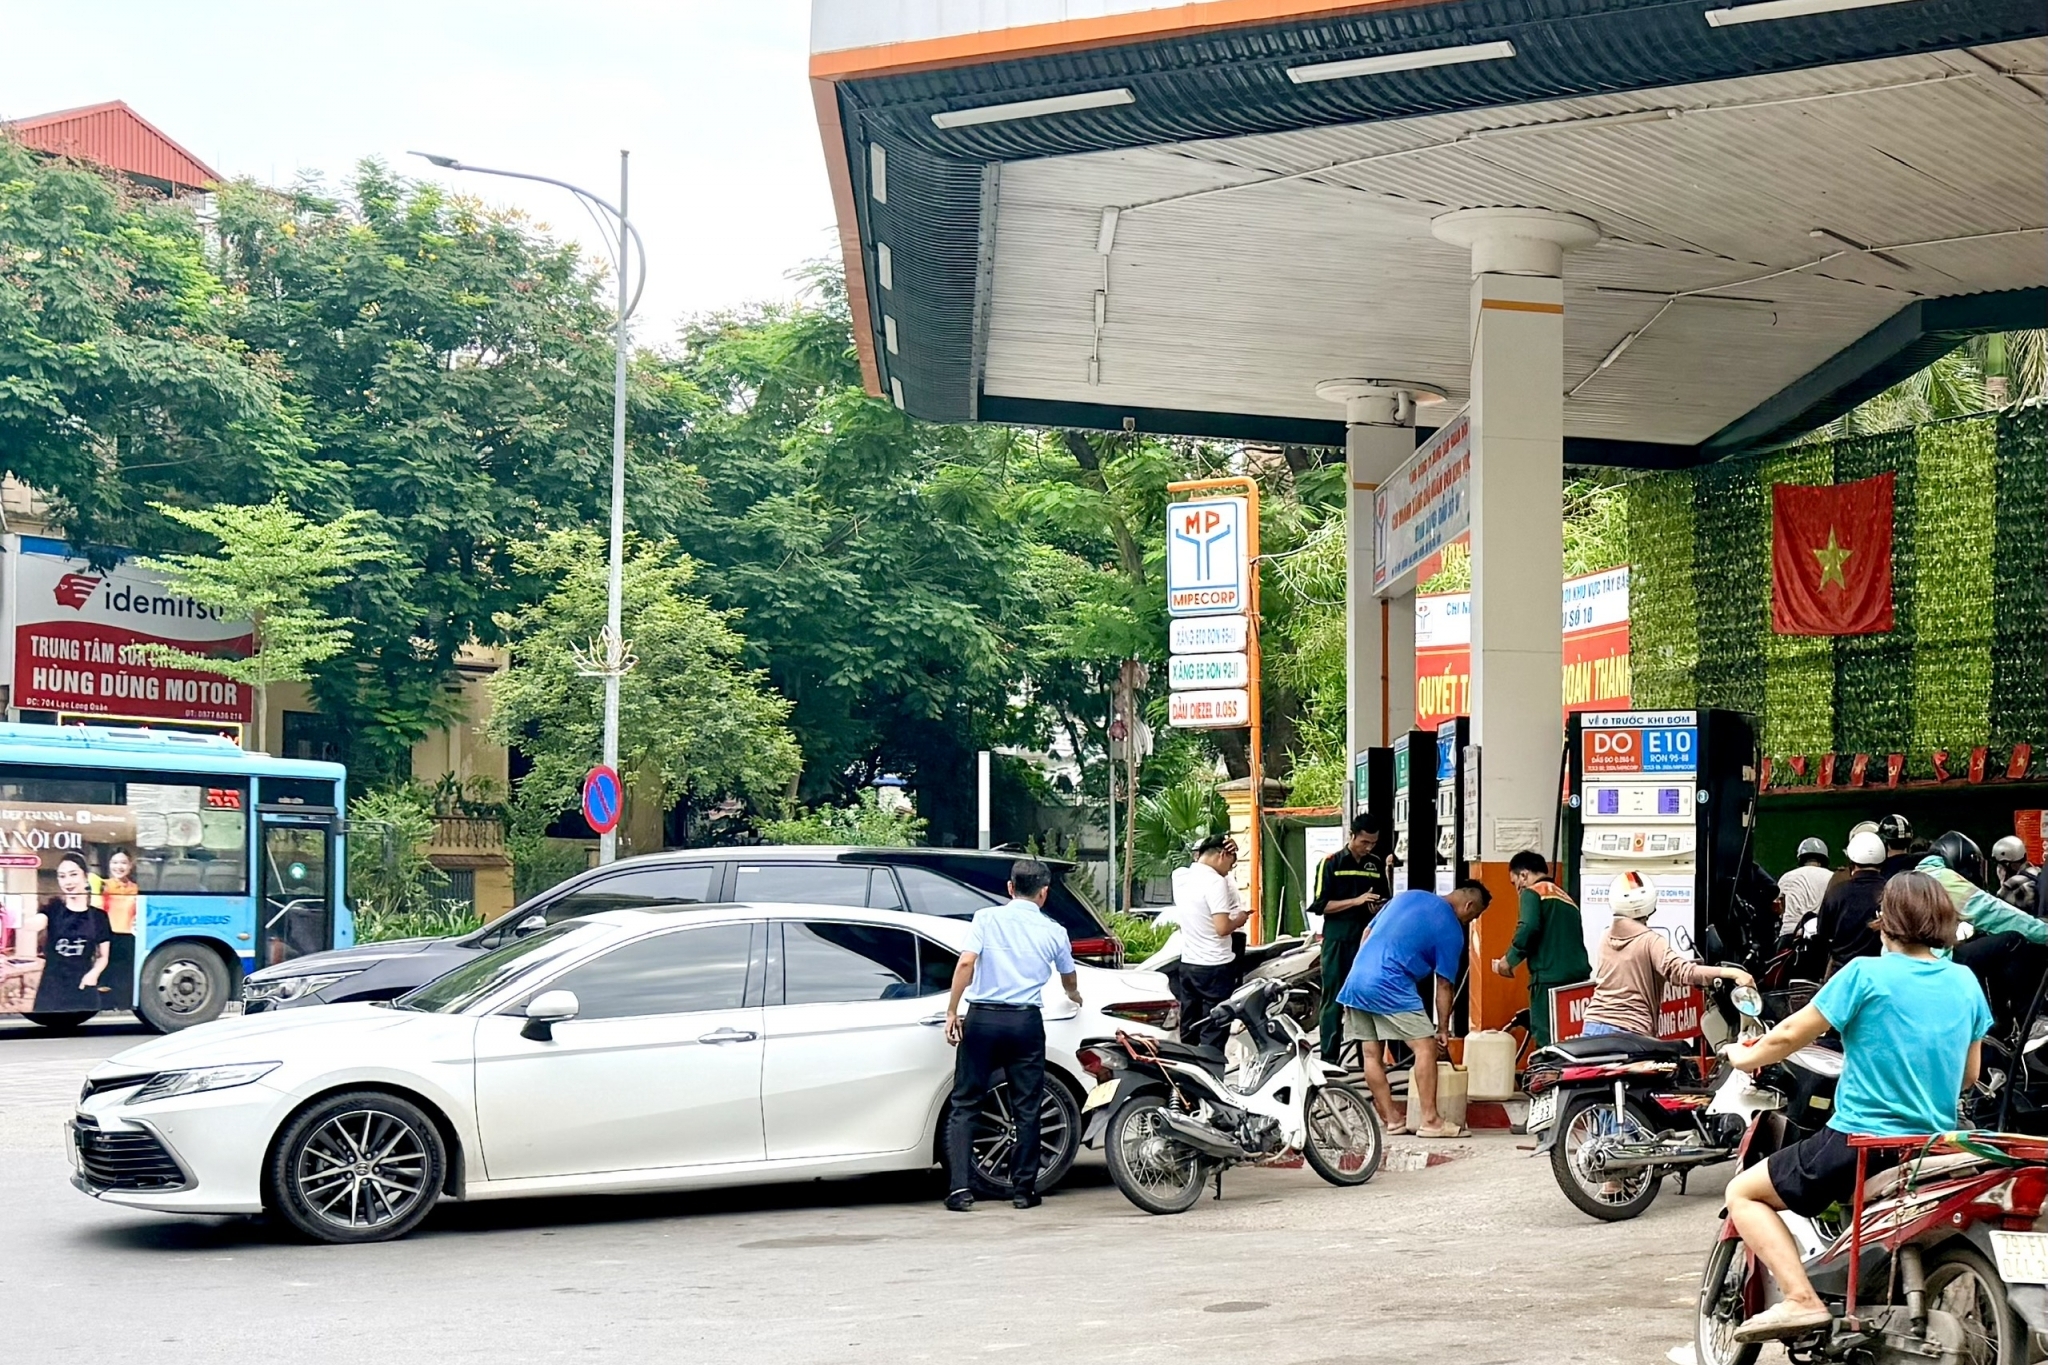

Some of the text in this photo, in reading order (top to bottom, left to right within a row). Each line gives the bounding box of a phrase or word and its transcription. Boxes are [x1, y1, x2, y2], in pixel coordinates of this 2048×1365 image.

[1186, 511, 1219, 534] MP
[1603, 575, 1615, 593] TÂY
[1173, 591, 1235, 607] MIPECORP
[1569, 603, 1581, 627] SỐ
[1583, 606, 1592, 624] 10
[1208, 628, 1220, 644] RON
[31, 636, 80, 665] TRUNG
[84, 637, 114, 664] TÂM
[1173, 660, 1195, 680] XĂNG
[1206, 662, 1221, 679] RON
[33, 664, 237, 706] HÙNG DŨNG MOTOR
[1419, 662, 1458, 719] QUYẾT
[1173, 696, 1188, 719] DẦU
[1216, 700, 1237, 718] 0.05S
[1611, 715, 1644, 725] TRƯỚC
[1648, 716, 1664, 724] KHI
[1667, 715, 1690, 724] BƠM
[1595, 732, 1632, 754] DO
[1649, 731, 1691, 753] E10
[1650, 754, 1667, 762] RON
[156, 912, 231, 927] HANOIBUS
